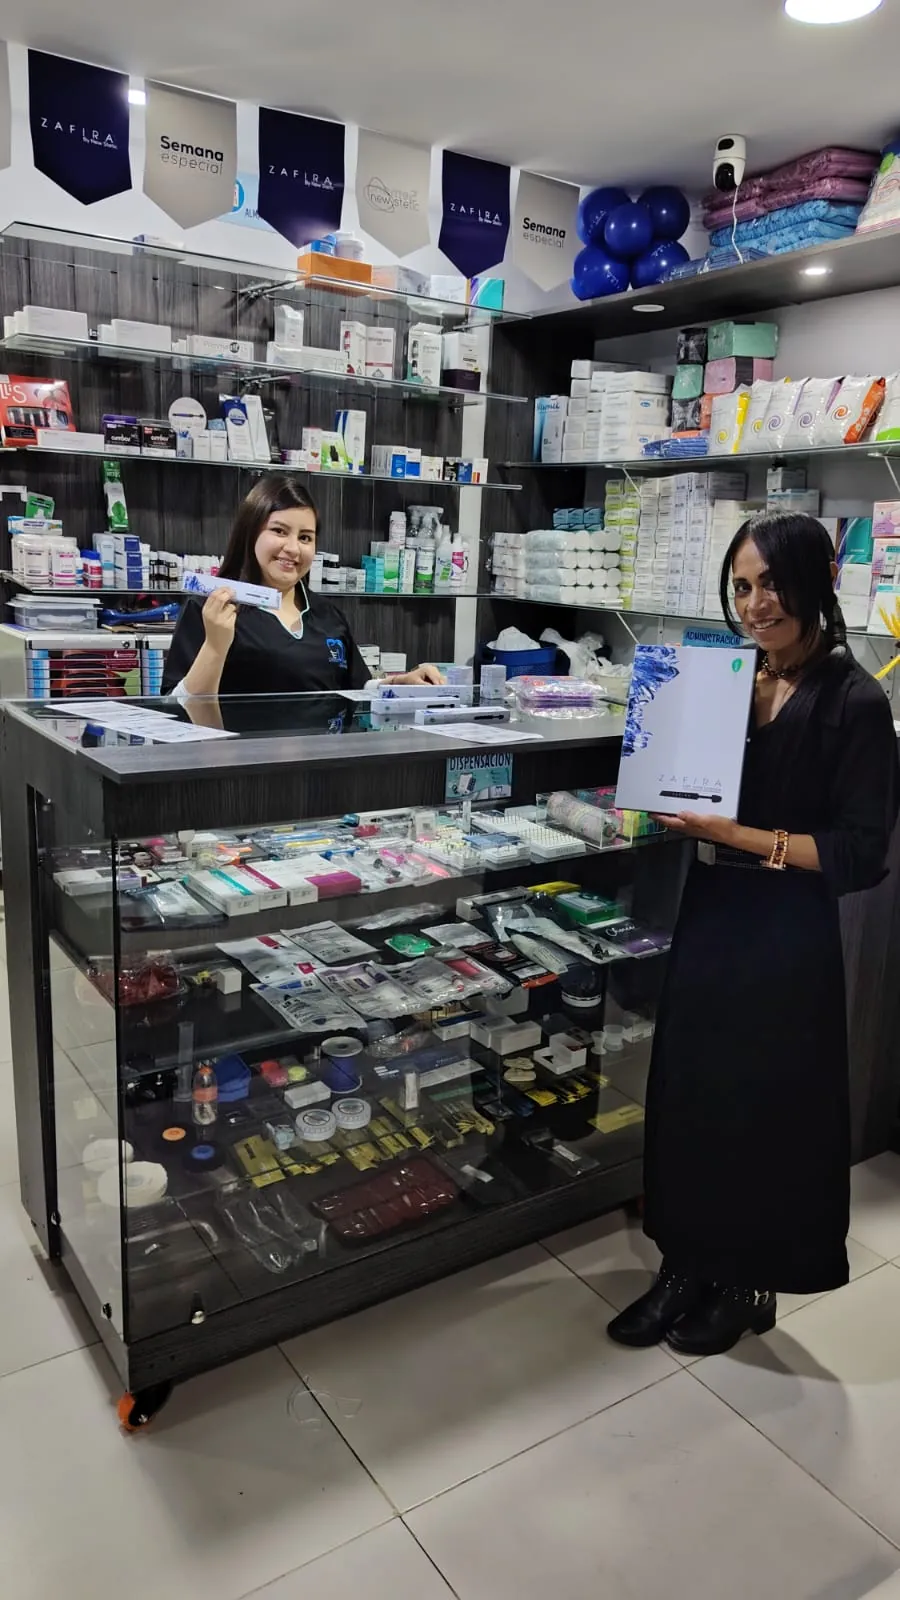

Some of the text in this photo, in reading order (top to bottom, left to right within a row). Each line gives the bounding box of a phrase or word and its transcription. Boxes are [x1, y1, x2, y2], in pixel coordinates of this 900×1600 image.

[40, 116, 114, 144] ZAFIRA
[160, 135, 224, 162] Semana
[161, 152, 223, 175] especial
[268, 165, 333, 187] ZAFIRA
[450, 202, 501, 224] ZAFIRA
[522, 217, 566, 239] Semana
